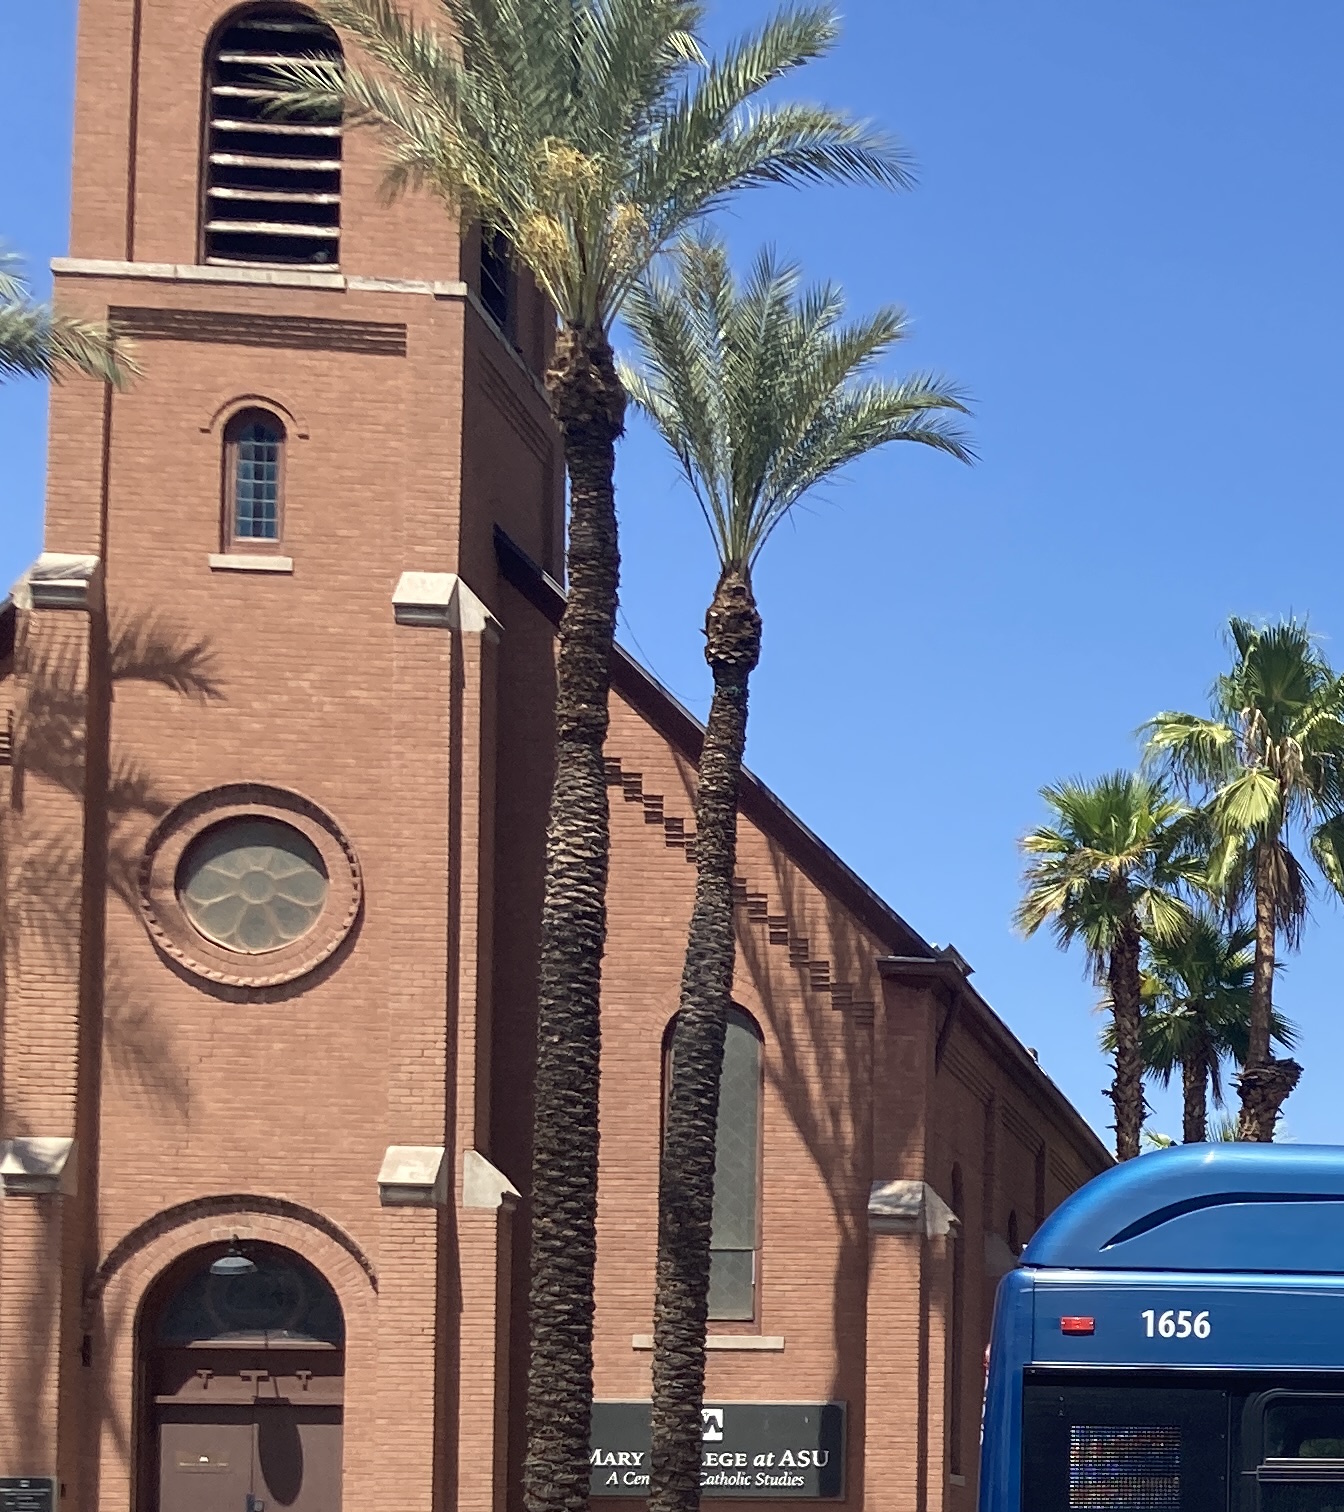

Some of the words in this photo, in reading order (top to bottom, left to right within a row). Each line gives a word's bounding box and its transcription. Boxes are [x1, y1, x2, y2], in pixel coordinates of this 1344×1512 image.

[1141, 1309, 1211, 1339] 1656
[589, 1448, 645, 1466] MARY
[753, 1452, 776, 1467] at
[778, 1449, 830, 1467] ASU
[605, 1471, 619, 1485] A
[699, 1471, 752, 1486] Catholic
[755, 1471, 805, 1486] Studies
